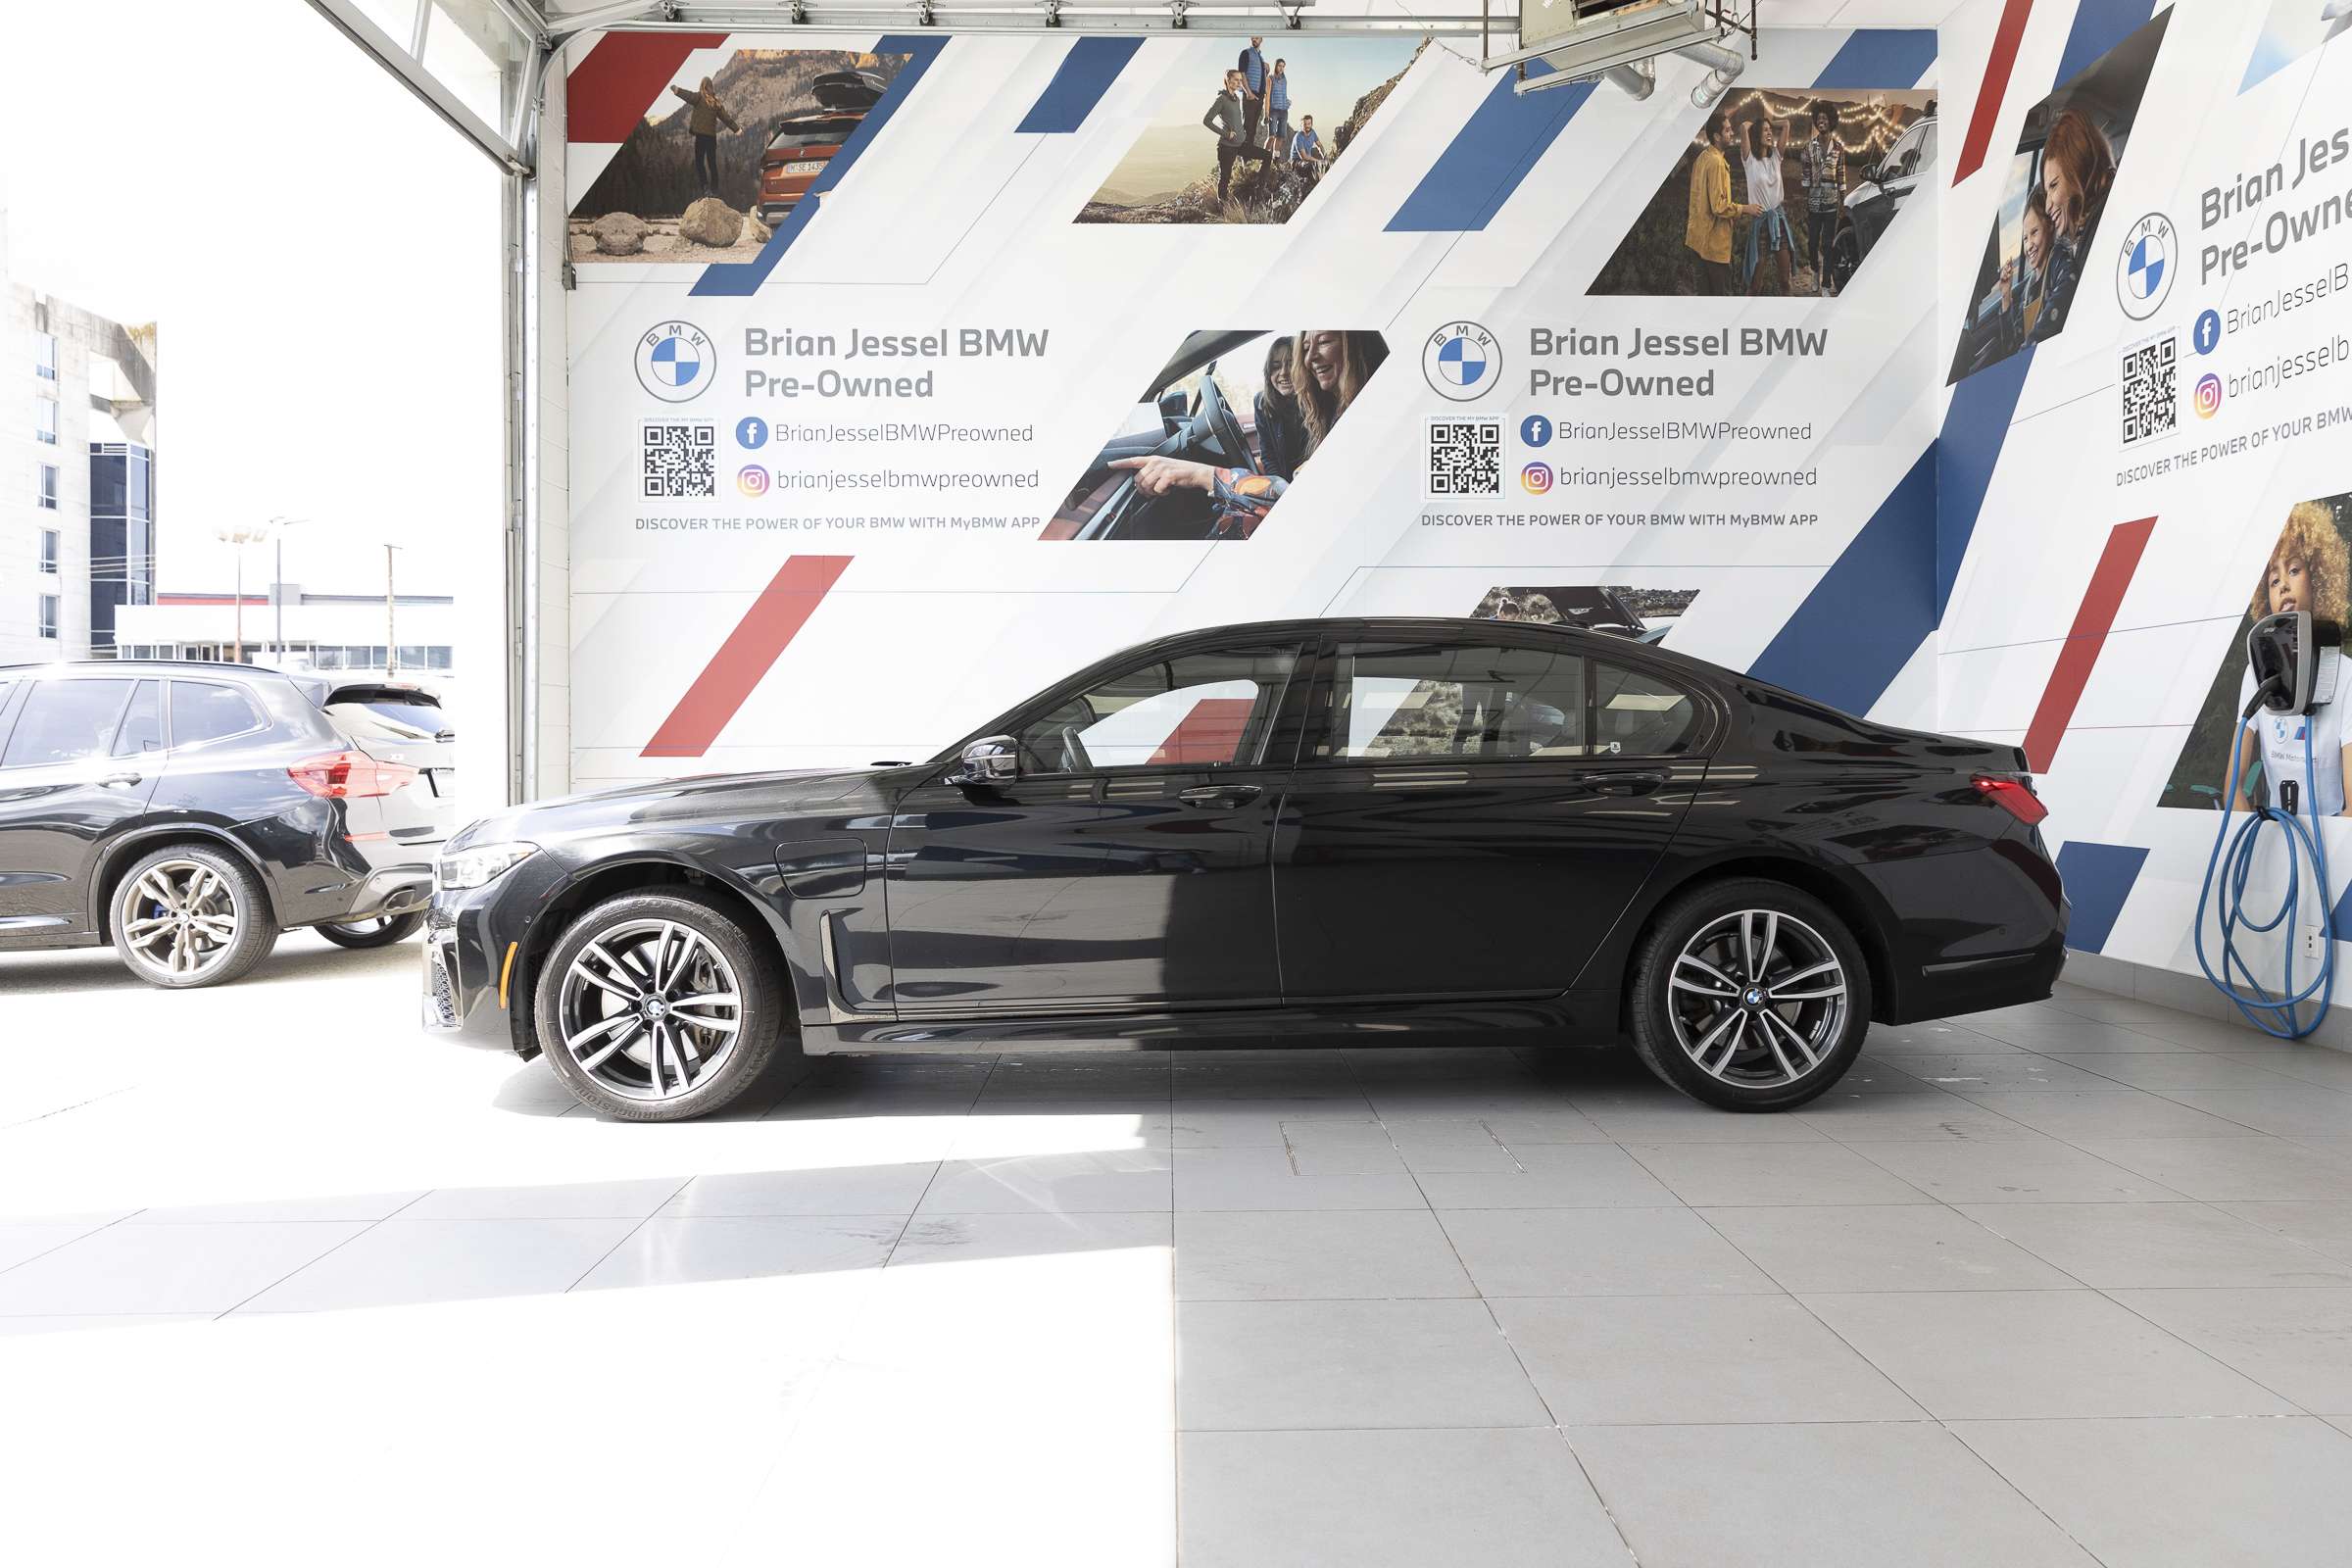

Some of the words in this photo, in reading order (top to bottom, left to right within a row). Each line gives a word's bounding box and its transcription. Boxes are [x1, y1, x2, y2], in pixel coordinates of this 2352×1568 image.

[2201, 163, 2283, 231] Brian
[2291, 127, 2350, 190] Jes
[2124, 219, 2170, 257] BMW
[2227, 263, 2350, 335] BrianJesselB
[645, 324, 706, 348] BMW
[745, 327, 836, 357] Brian
[844, 327, 948, 361] Jessel
[959, 328, 1050, 358] BMW
[1433, 324, 1492, 347] BMW
[1530, 327, 1619, 356] Brian
[1627, 327, 1729, 360] Jessel
[1740, 327, 1829, 357] BMW
[2227, 334, 2350, 399] brianjesselb
[745, 368, 934, 398] Pre-Owned
[1530, 368, 1714, 397] Pre-Owned
[775, 422, 1035, 443] BrianJesselBMWPreowned
[1559, 421, 1812, 441] BrianJesselBMWPreowned
[2116, 457, 2172, 487] DISCOVER
[2173, 449, 2198, 471] THE
[2200, 435, 2248, 463] POWER
[2250, 428, 2270, 449] OF
[2271, 416, 2313, 442] YOUR
[2316, 406, 2352, 430] BMW
[777, 468, 1039, 492] brianjesselbmwpreowned
[1560, 466, 1817, 490] brianjesselbmwpreowned
[635, 517, 709, 531] DISCOVER
[711, 517, 742, 530] THE
[745, 517, 799, 530] POWER
[803, 517, 822, 530] OF
[825, 516, 865, 530] YOUR
[869, 516, 906, 529] BMW
[908, 516, 947, 529] WITH
[950, 516, 1007, 531] MyBMW
[1010, 516, 1041, 529] APP
[1421, 514, 1493, 526] DISCOVER
[1495, 514, 1526, 526] THE
[1529, 514, 1581, 526] POWER
[1585, 514, 1604, 526] OF
[1606, 514, 1646, 526] YOUR
[1649, 514, 1686, 526] BMW
[1689, 514, 1726, 526] WITH
[1730, 514, 1786, 528] MyBMW
[1788, 514, 1819, 526] APP
